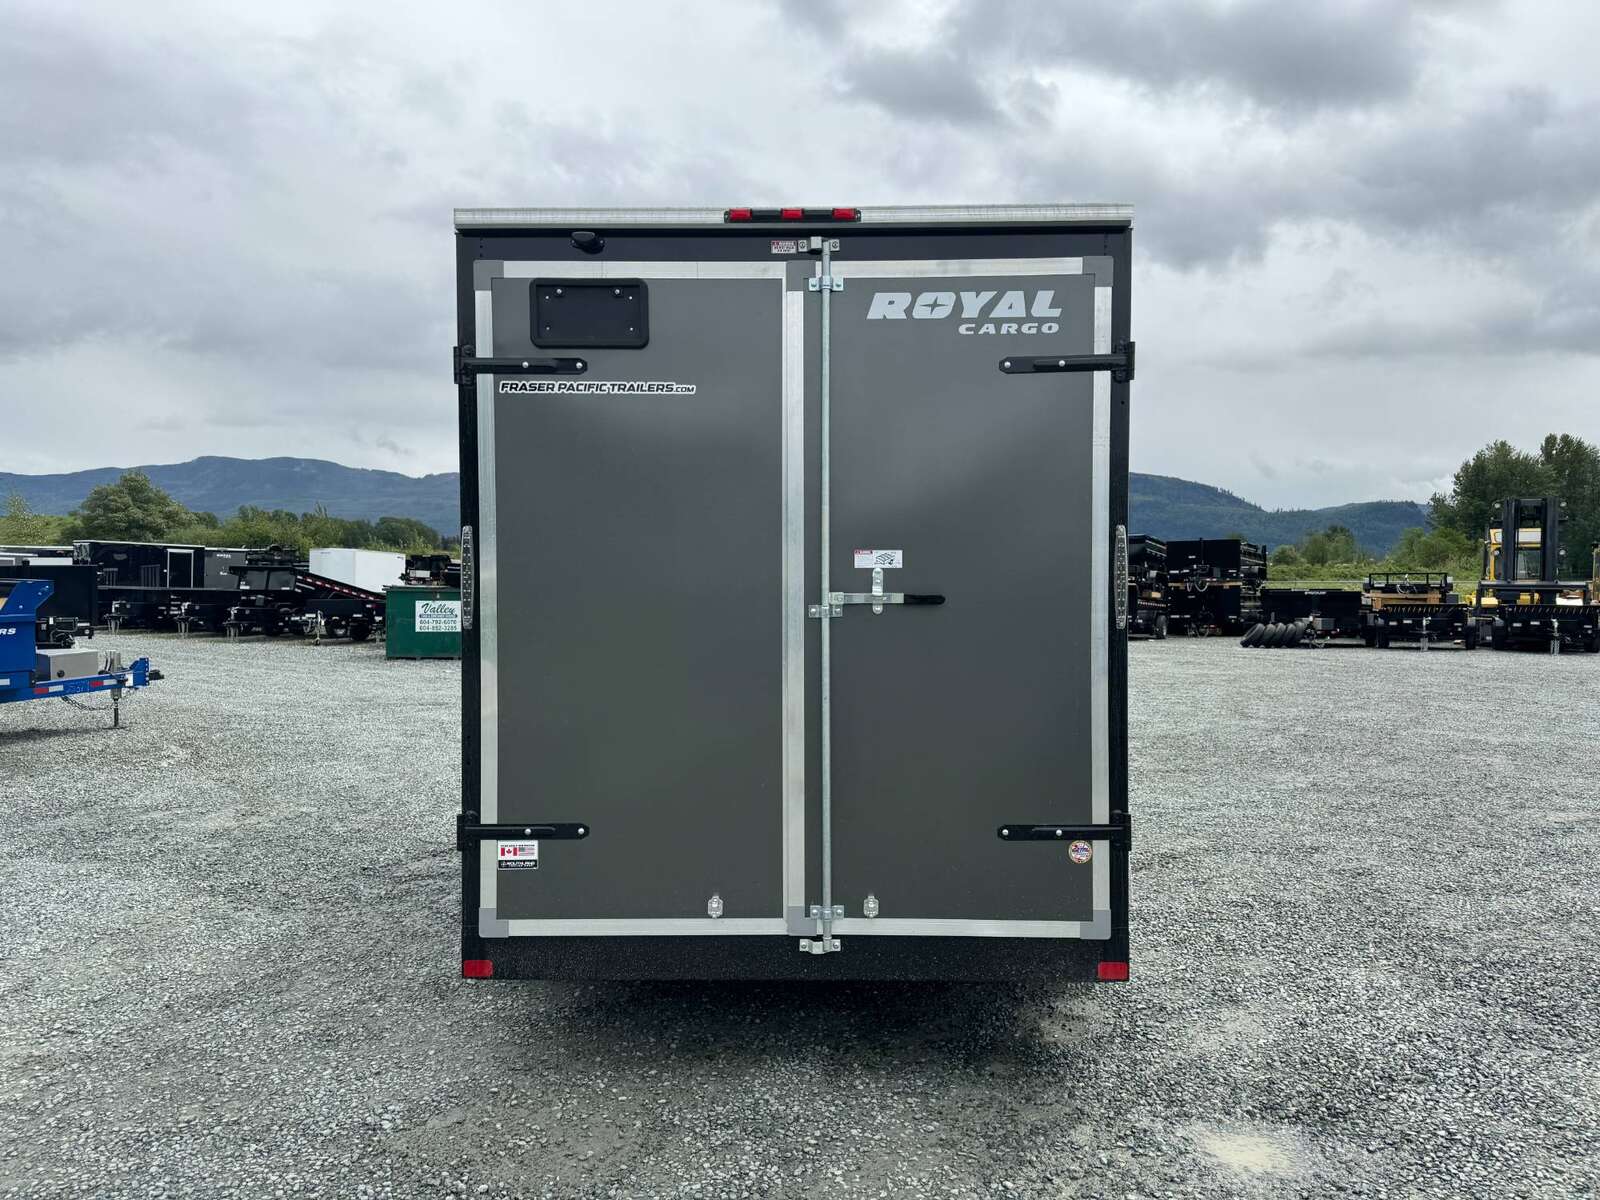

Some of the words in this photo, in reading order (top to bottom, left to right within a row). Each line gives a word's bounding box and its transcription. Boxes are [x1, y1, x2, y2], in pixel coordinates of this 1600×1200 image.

[866, 290, 1062, 319] ROYAL
[958, 322, 1060, 335] CARGO
[500, 381, 556, 393] FRASER
[557, 381, 607, 393] PACIFIC
[421, 603, 455, 614] Valley
